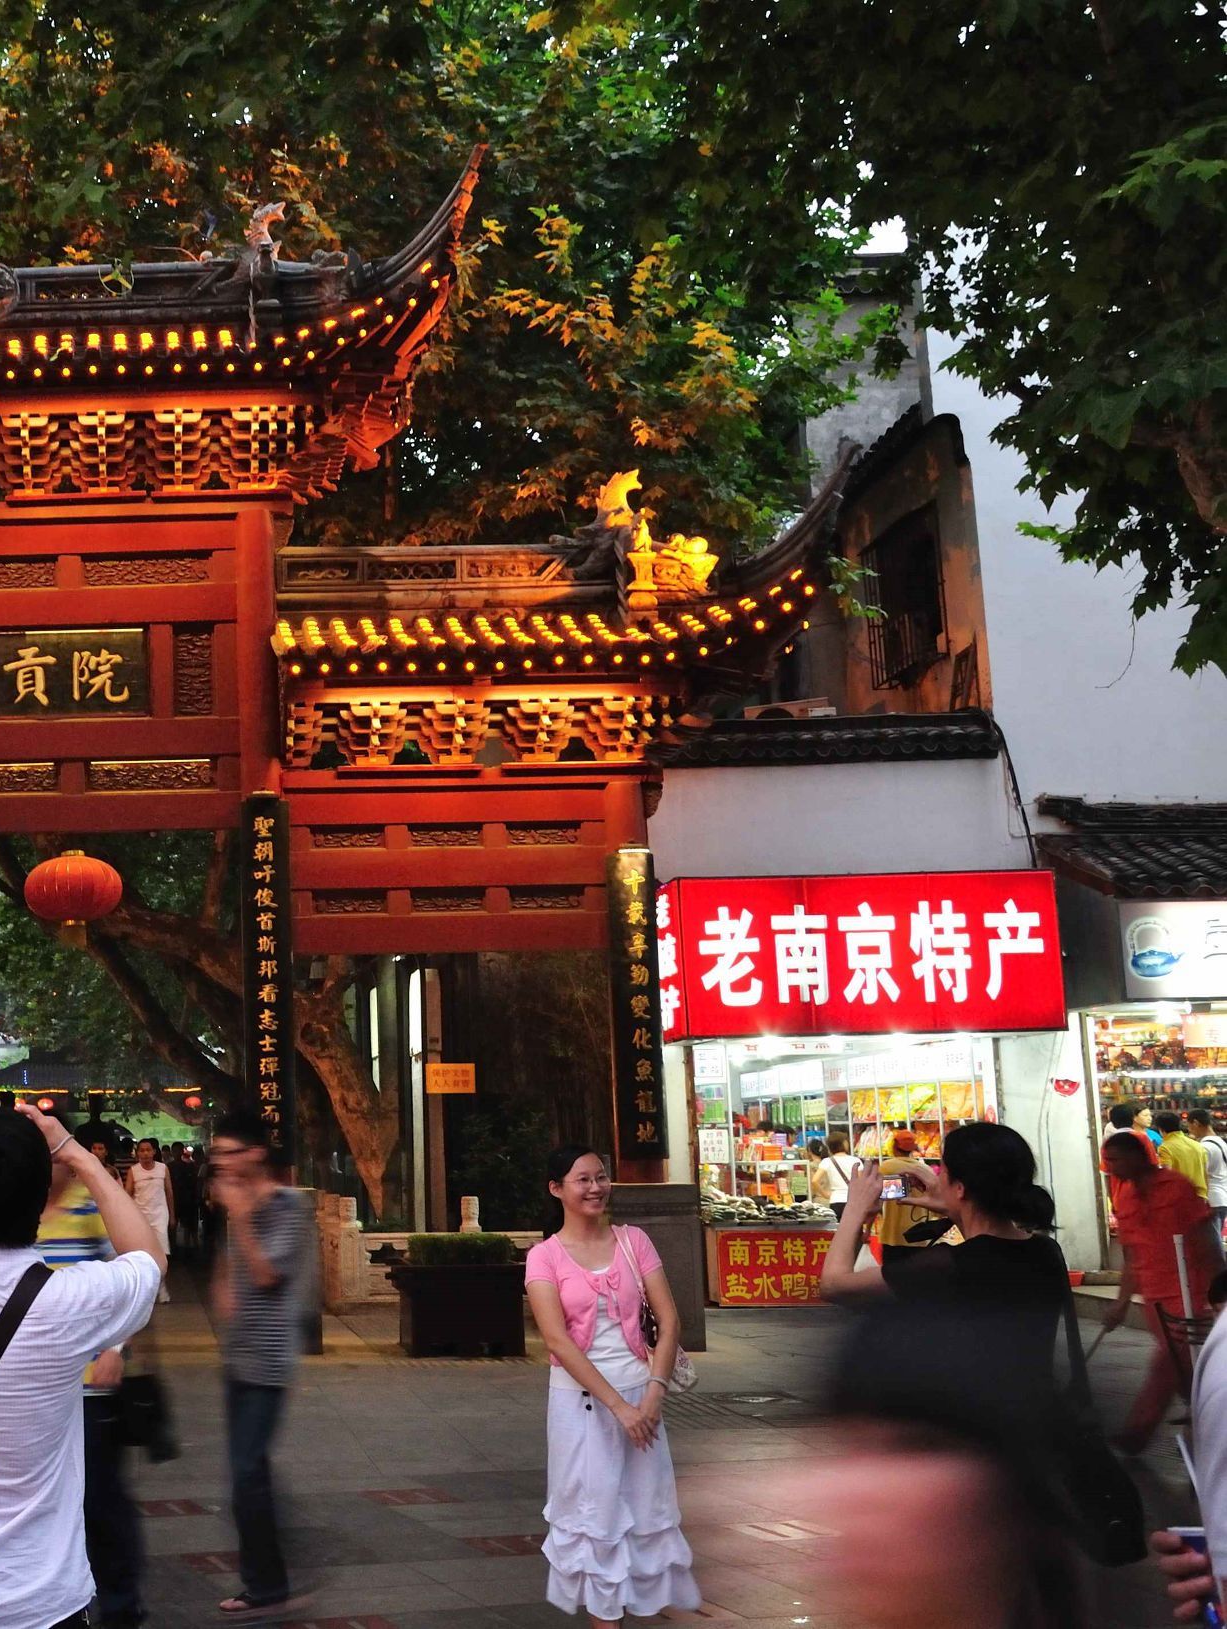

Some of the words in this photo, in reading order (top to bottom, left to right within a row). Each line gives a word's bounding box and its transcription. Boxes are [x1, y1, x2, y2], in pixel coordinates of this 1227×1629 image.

[698, 898, 1044, 1007] 老南京特产
[727, 1238, 830, 1266] 南京特产
[725, 1271, 809, 1300] 盐水鸭
